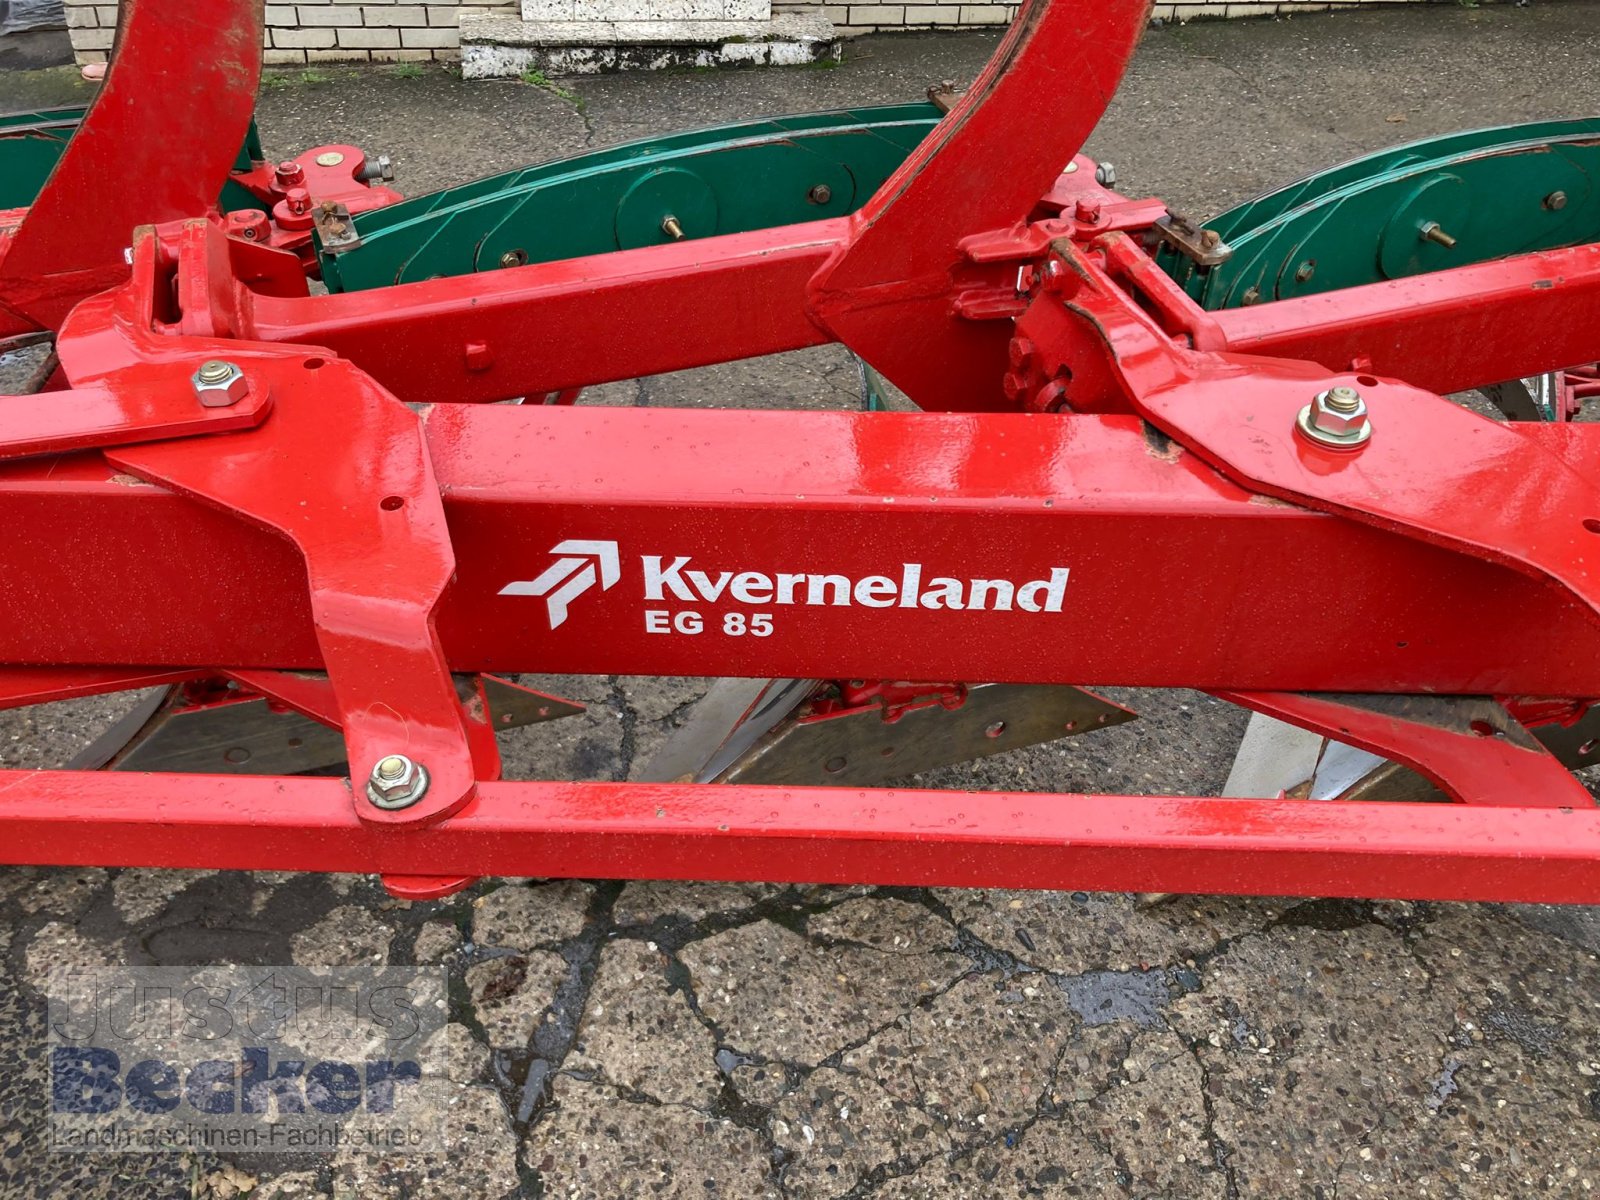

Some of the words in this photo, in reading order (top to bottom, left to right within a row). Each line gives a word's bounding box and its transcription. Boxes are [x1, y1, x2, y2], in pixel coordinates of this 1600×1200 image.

[642, 555, 1070, 613] Kverneland
[645, 610, 704, 635] EG
[723, 612, 774, 637] 85
